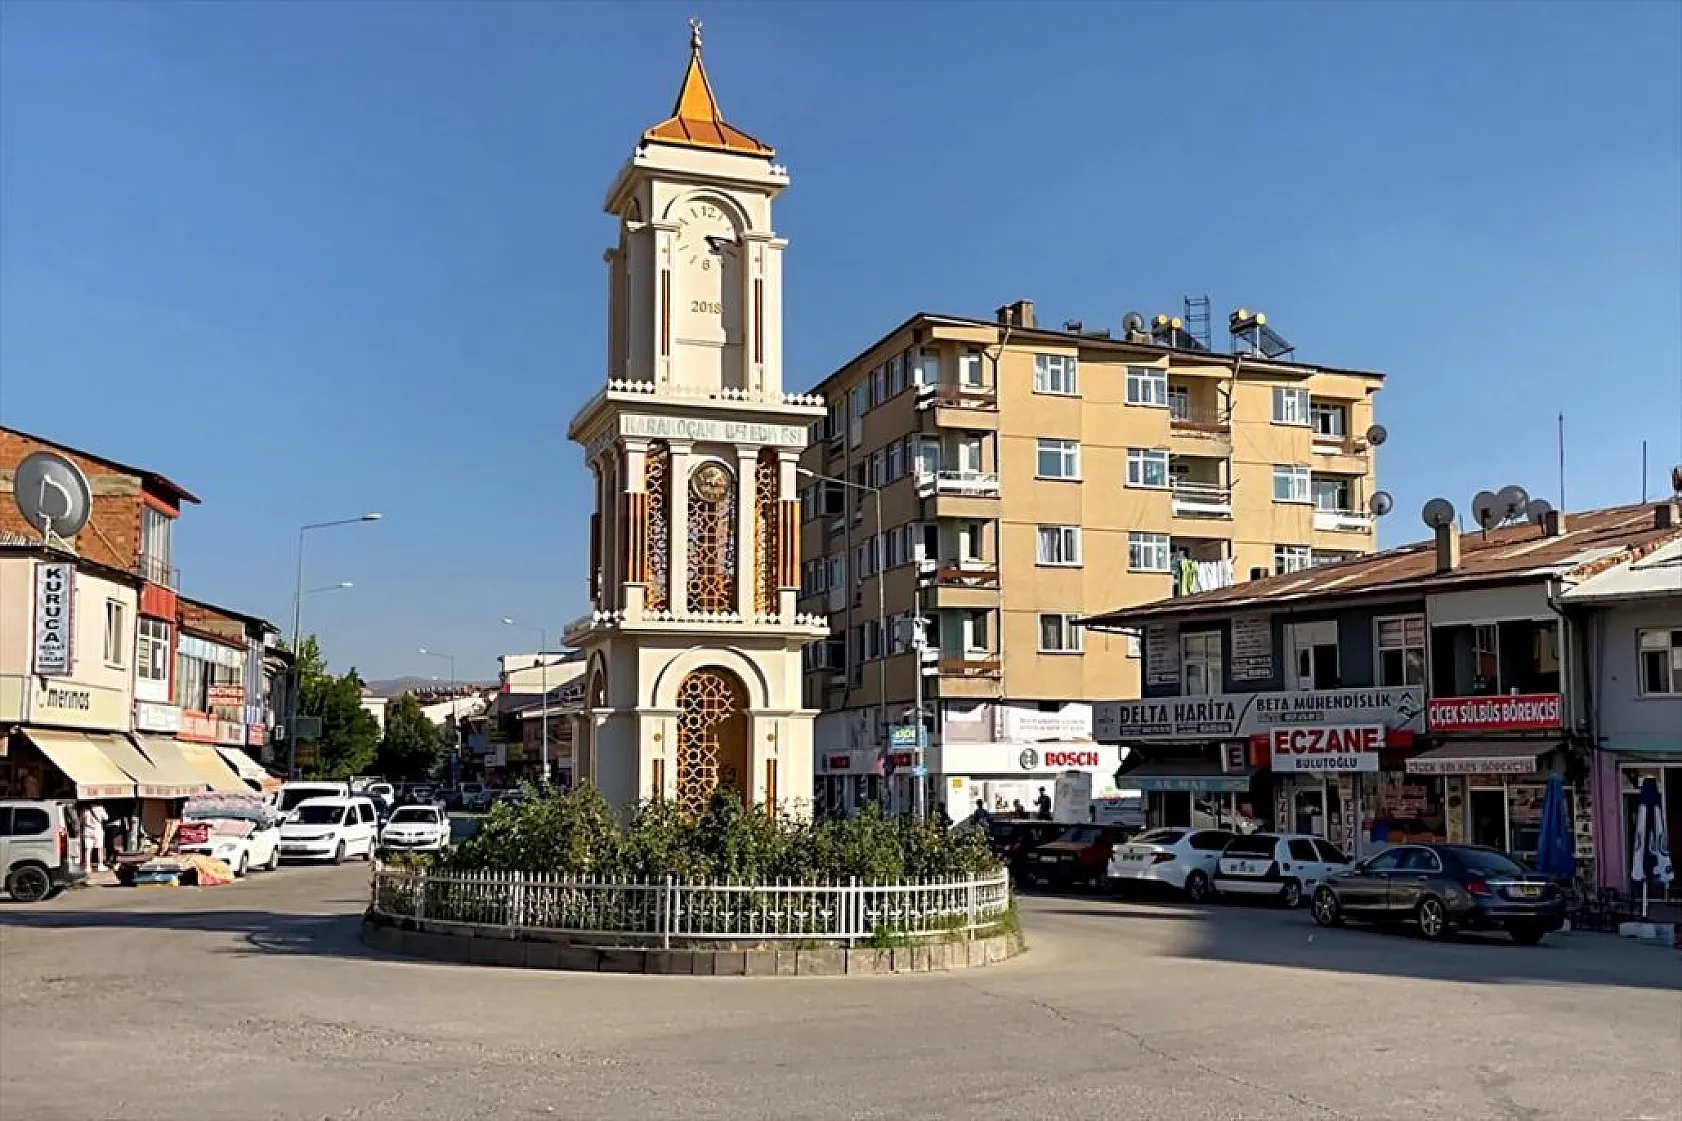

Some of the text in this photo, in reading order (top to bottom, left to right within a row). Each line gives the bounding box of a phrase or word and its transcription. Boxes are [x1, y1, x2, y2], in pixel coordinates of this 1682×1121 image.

[701, 205, 716, 218] 12
[690, 300, 722, 315] 2018
[1256, 692, 1392, 711] BETA MÜHENDİSLİK
[1120, 703, 1168, 723] DELTA
[1174, 699, 1235, 722] HARİTA
[1430, 697, 1560, 728] ÇİÇEK SÜLBÜS BÖREKÇİSİ
[1274, 728, 1379, 755] ECZANE
[1045, 751, 1099, 767] BOSCH
[1295, 756, 1358, 769] BULUTOĞLU
